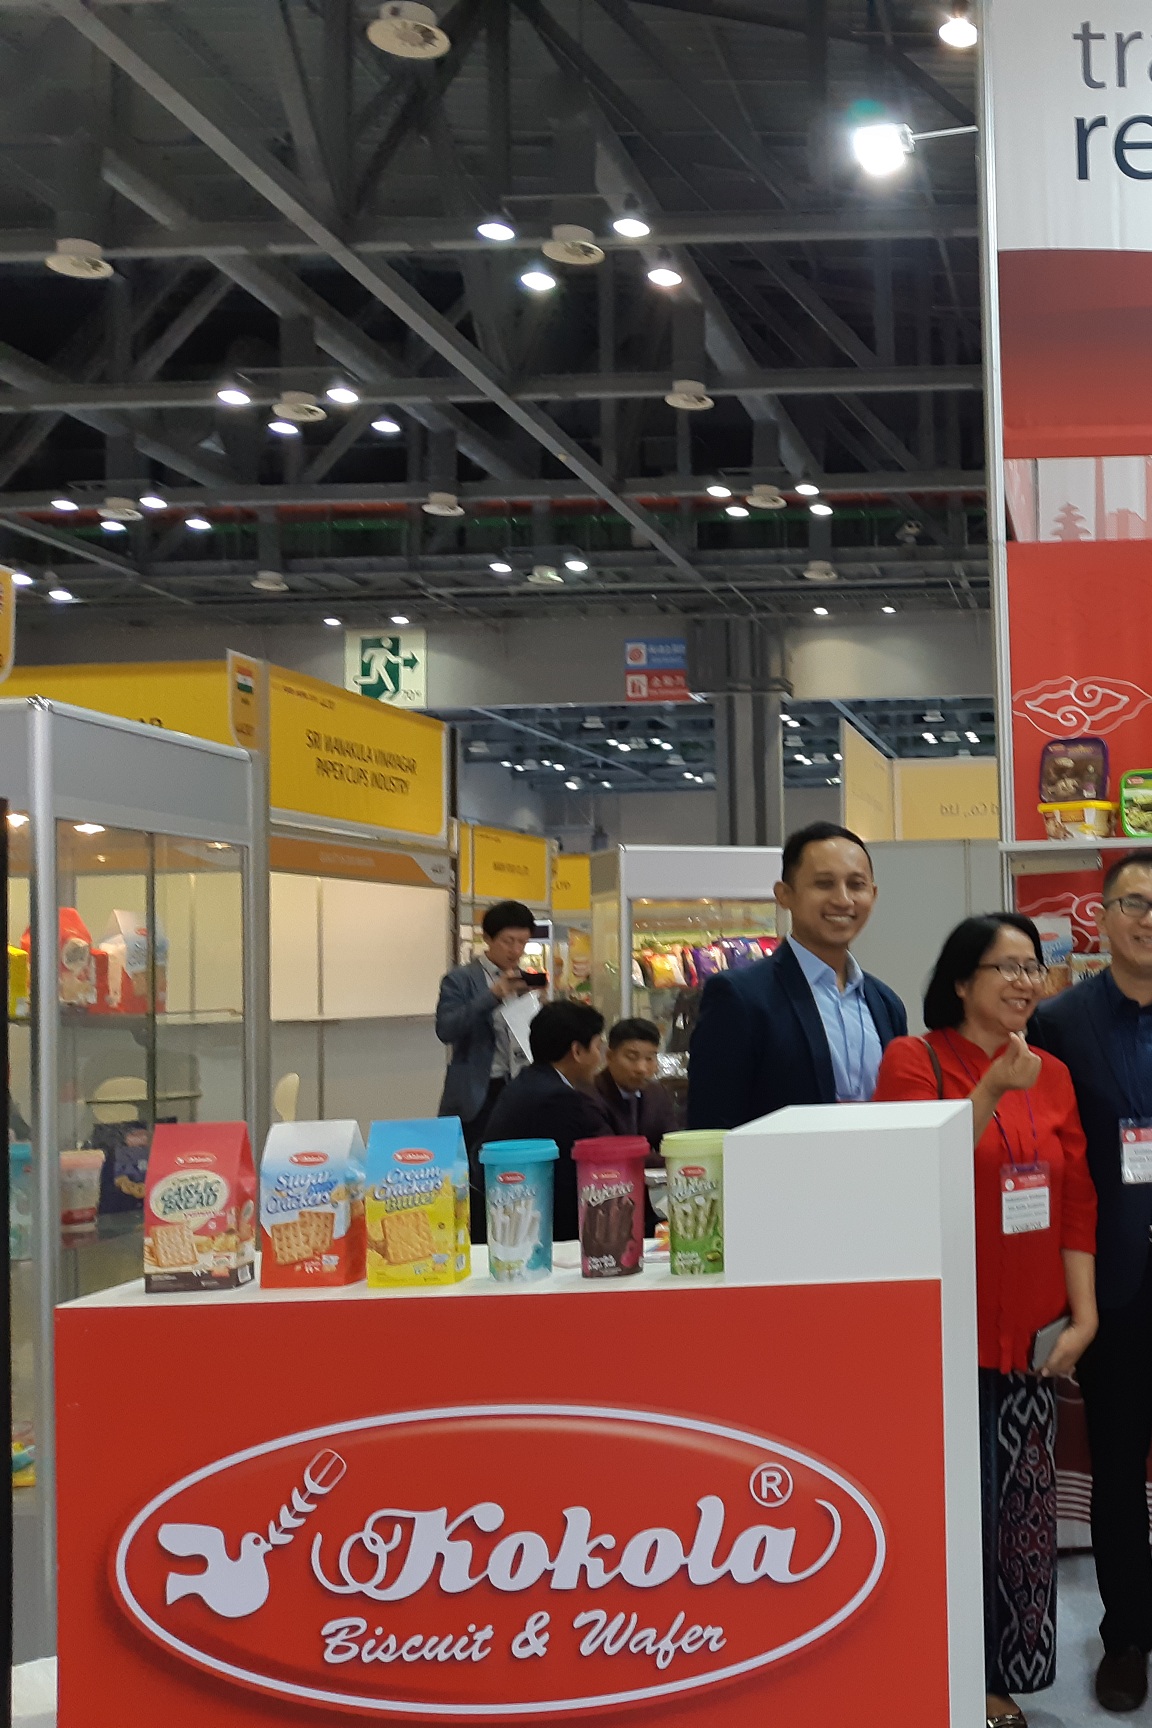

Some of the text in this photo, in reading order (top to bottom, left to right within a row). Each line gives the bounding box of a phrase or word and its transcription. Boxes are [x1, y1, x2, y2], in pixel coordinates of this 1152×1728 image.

[311, 1494, 842, 1600] Kokola
[320, 1608, 728, 1671] Biscuit & Wafer
